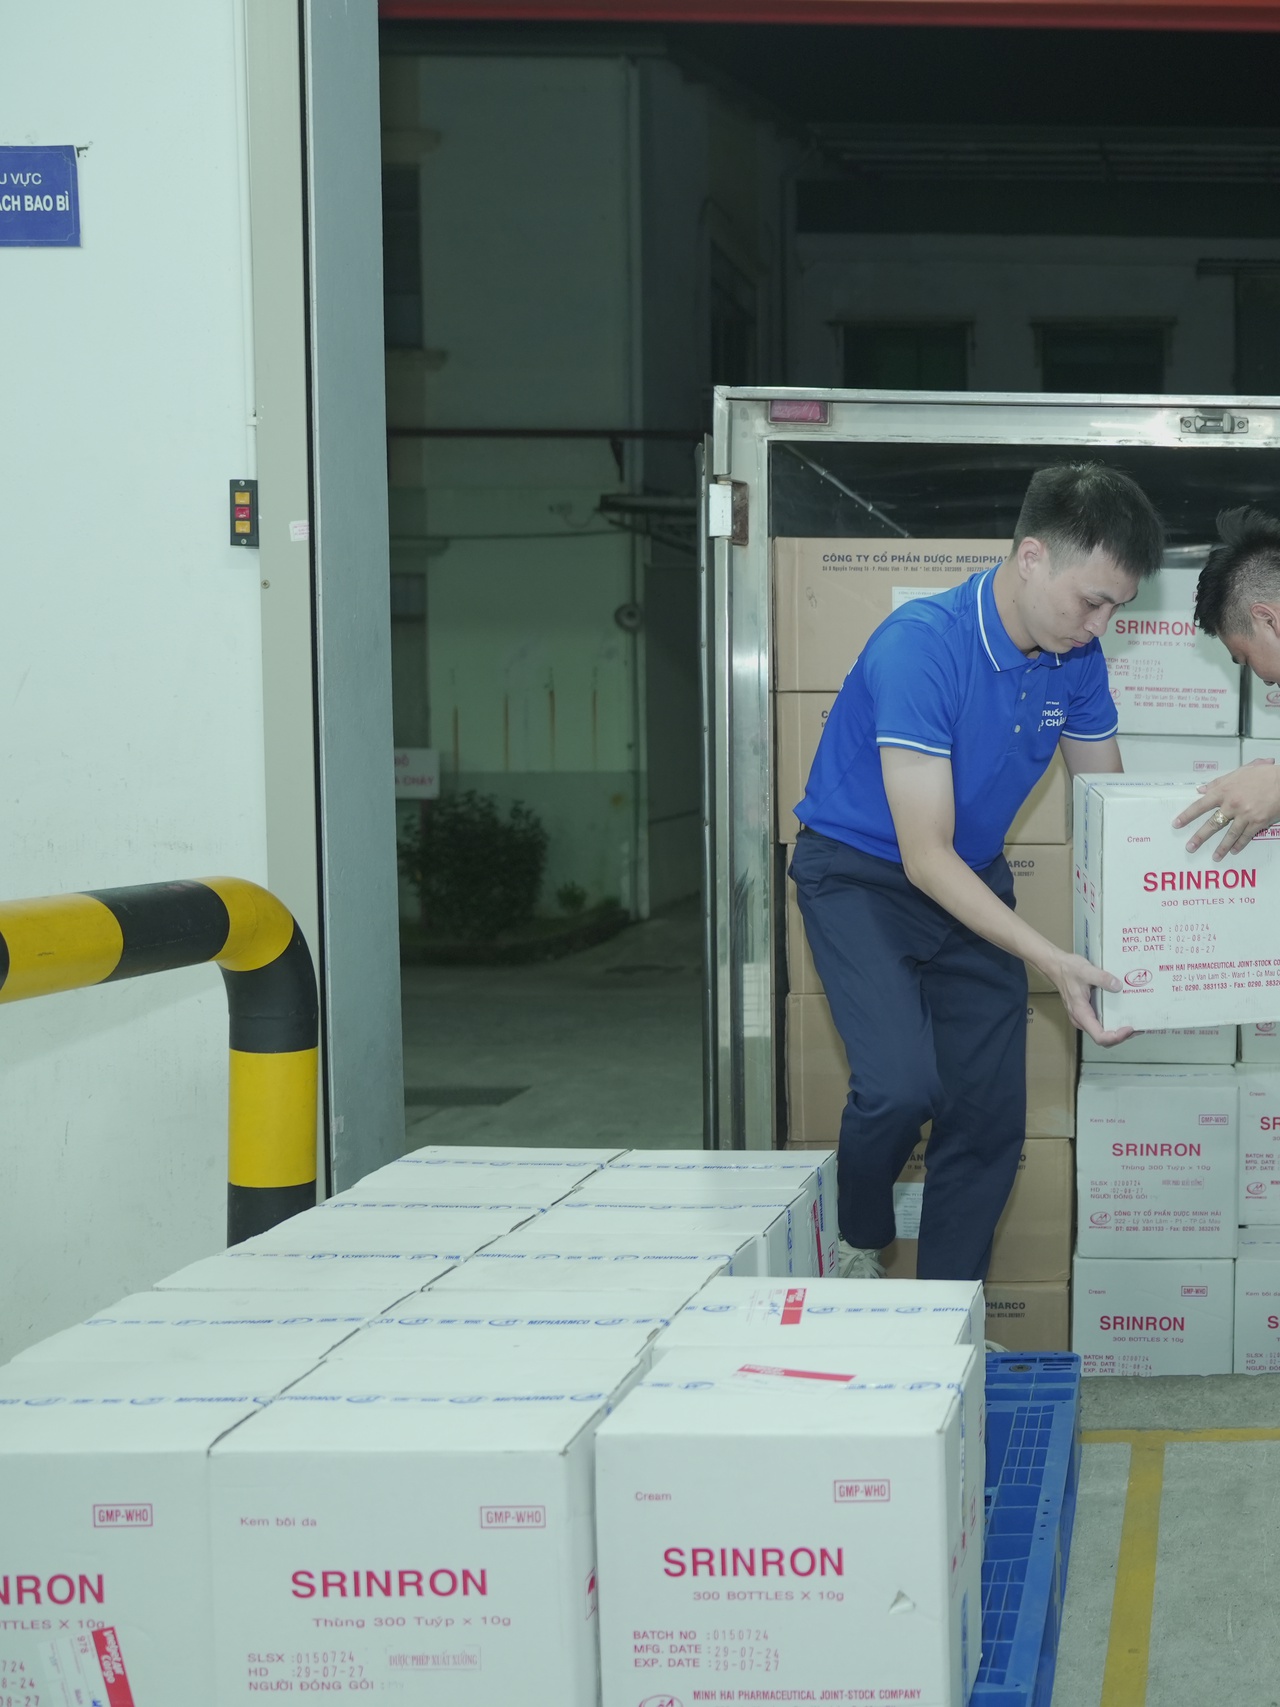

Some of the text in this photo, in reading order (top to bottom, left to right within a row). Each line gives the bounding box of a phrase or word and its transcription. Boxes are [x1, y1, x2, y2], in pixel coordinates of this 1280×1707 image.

[10, 173, 42, 187] VỰC
[24, 195, 53, 211] BAO
[56, 191, 69, 211] BÌ
[823, 553, 852, 563] CÔNG
[856, 555, 869, 563] TY
[1115, 620, 1196, 636] SRINRON
[1143, 868, 1257, 892] SRINRON
[1161, 899, 1178, 907] 300
[1183, 898, 1225, 906] BOTTLES
[1239, 897, 1255, 905] 10g
[1122, 927, 1148, 935] BATCH
[1152, 926, 1162, 934] NO
[1145, 935, 1166, 943] DATE
[1176, 934, 1217, 942] 02-08-24
[1175, 946, 1215, 954] 02-08-27
[1187, 961, 1235, 970] PHARMACEUTICAL
[1237, 959, 1271, 968] JOINT-STOCK
[1112, 1143, 1201, 1156] SRINRON
[1100, 1315, 1185, 1331] SRINRON
[635, 1491, 672, 1502] Cream
[839, 1484, 886, 1498] GMP-WHO
[98, 1509, 148, 1522] GMP-WHO
[486, 1511, 541, 1524] GMP-WHO
[240, 1516, 317, 1528] Kem bôi da
[664, 1548, 844, 1577] SRINRON
[291, 1569, 488, 1599] SRINRON
[693, 1591, 720, 1601] 300
[727, 1591, 794, 1601] BOTTLES
[818, 1591, 844, 1603] 10g
[312, 1616, 365, 1629] Thùng
[374, 1617, 406, 1627] 300
[414, 1616, 455, 1628] Tuýp
[481, 1615, 512, 1627] 10g
[633, 1630, 674, 1641] BATCH
[679, 1630, 697, 1640] NO
[634, 1644, 664, 1655] MFG.
[670, 1643, 702, 1654] DATE
[247, 1653, 285, 1663] SLSX
[634, 1658, 662, 1668] EXP.
[668, 1658, 700, 1668] DATE
[248, 1667, 269, 1678] HD
[693, 1689, 922, 1700] MINH HAI PHARMACEUTICAL JOINT-STOCK COMPANY
